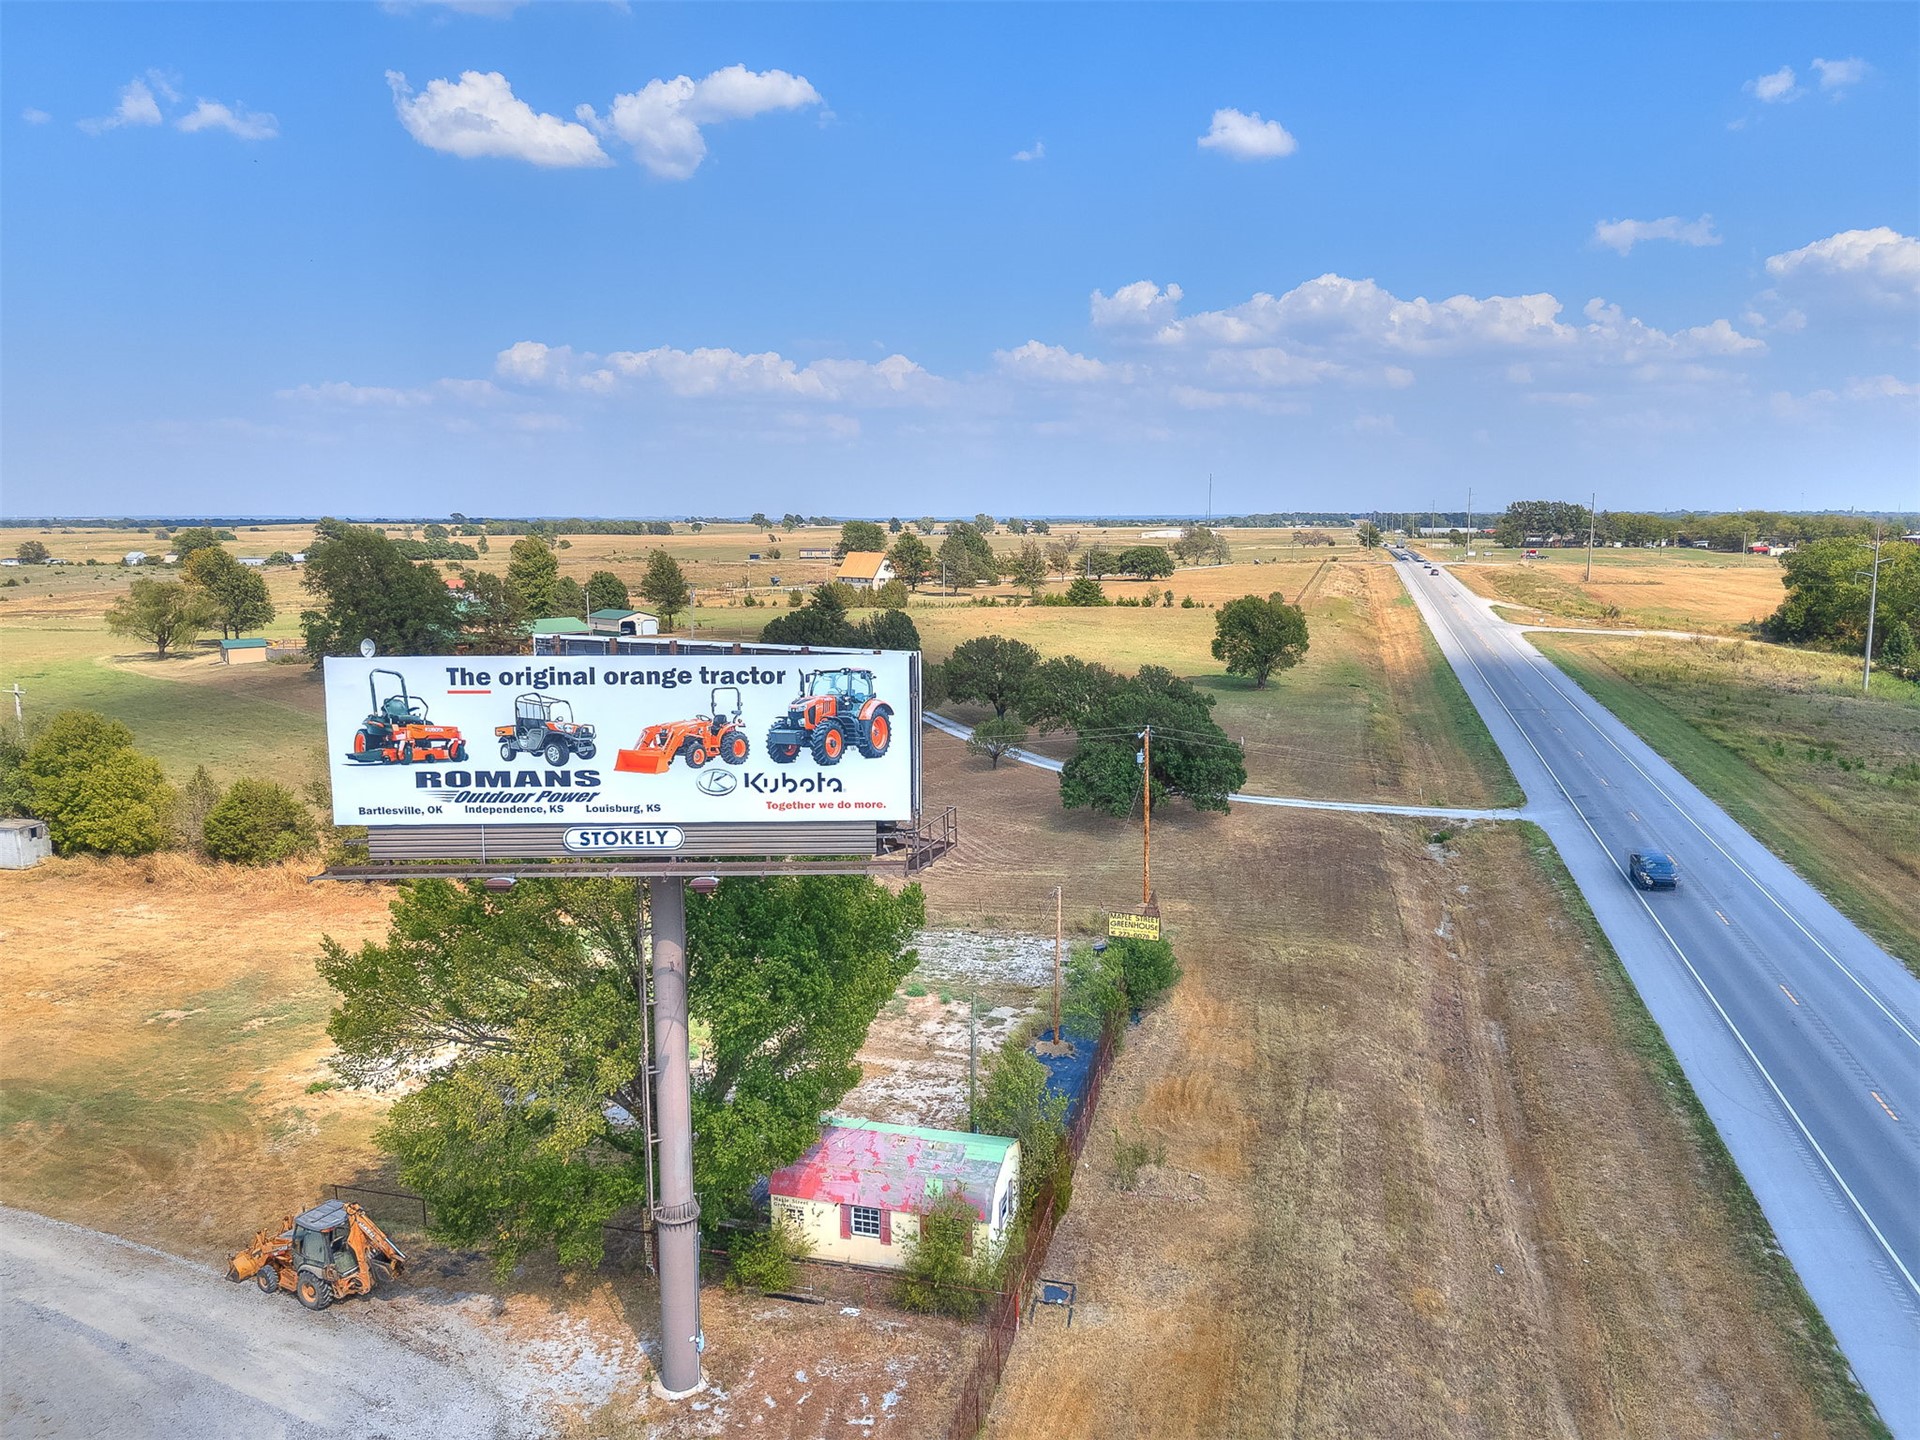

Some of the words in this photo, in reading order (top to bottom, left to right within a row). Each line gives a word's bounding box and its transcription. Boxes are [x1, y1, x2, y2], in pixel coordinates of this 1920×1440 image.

[446, 667, 491, 686] The
[499, 666, 595, 690] original
[603, 667, 692, 689] orange
[699, 666, 786, 685] tractor
[415, 769, 602, 788] ROMANS
[744, 772, 842, 793] Kubota
[454, 790, 536, 804] Outdoor
[535, 790, 601, 803] Power
[358, 806, 425, 816] Bartlesville,
[427, 805, 444, 814] OK
[465, 804, 547, 815] Independence,
[549, 804, 565, 813] KS
[585, 804, 644, 815] Louisburg,
[646, 804, 662, 812] KS
[766, 801, 815, 811] Together
[837, 800, 852, 809] do
[854, 801, 886, 809] more.
[580, 830, 669, 846] STOKELY
[1135, 915, 1158, 923] STREET
[1110, 920, 1158, 931] GREENHOUSE
